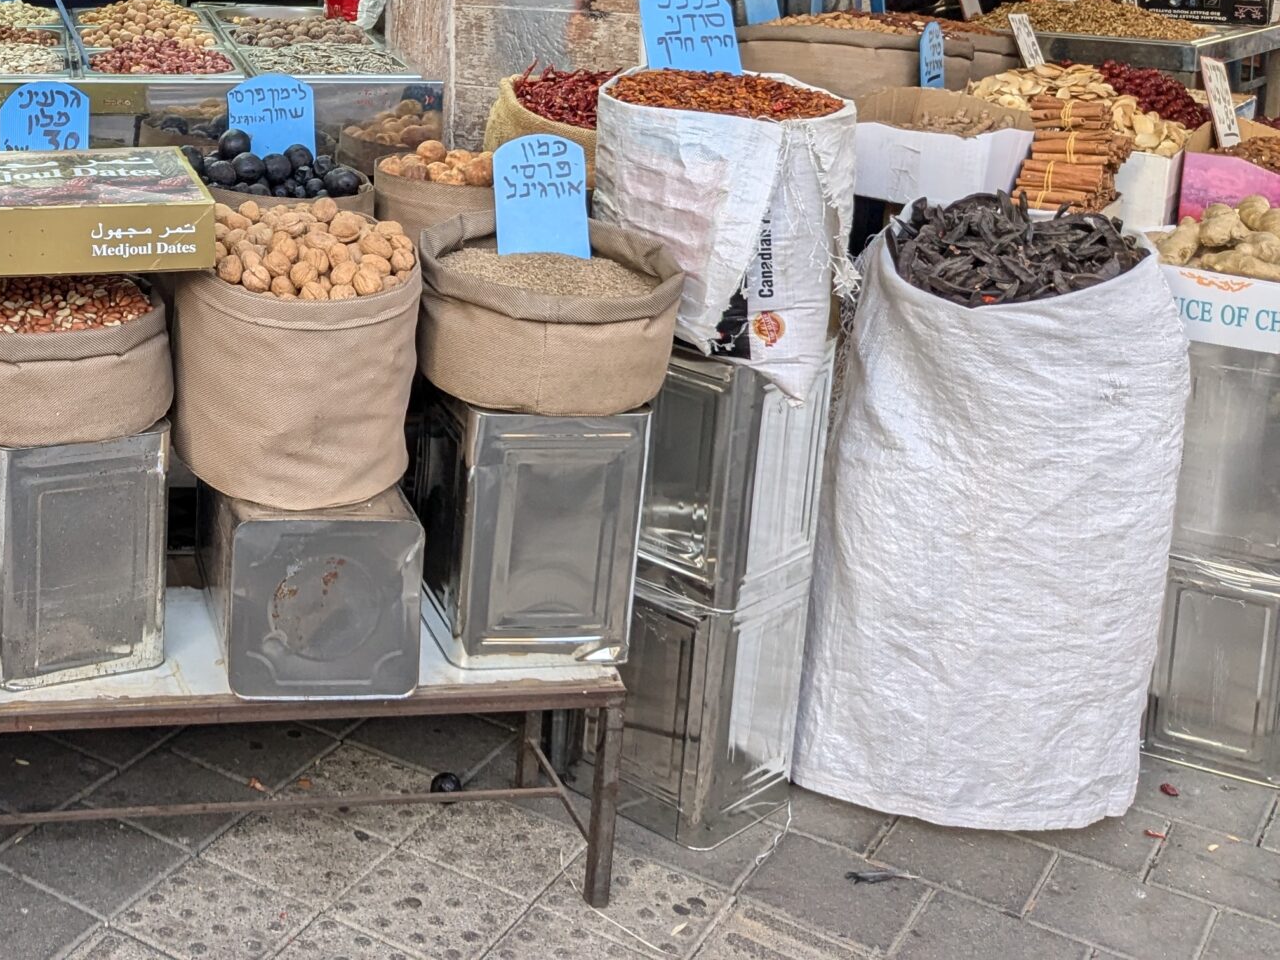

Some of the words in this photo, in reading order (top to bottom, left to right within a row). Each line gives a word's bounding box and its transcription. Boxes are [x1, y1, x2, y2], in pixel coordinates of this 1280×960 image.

[664, 13, 726, 37] סודני
[657, 36, 696, 66] חריף
[698, 34, 735, 58] חריף
[17, 89, 81, 109] גרעיני
[228, 88, 266, 106] פרסי
[267, 83, 307, 108] לימון
[521, 139, 568, 163] כמון
[73, 166, 162, 178] Dates
[511, 160, 572, 180] פרסי
[503, 175, 584, 200] אורגינל
[90, 223, 152, 239] مجهول
[158, 223, 196, 237] تمر
[91, 244, 153, 257] Medjoul
[156, 242, 196, 254] Dates
[1220, 304, 1249, 328] OF
